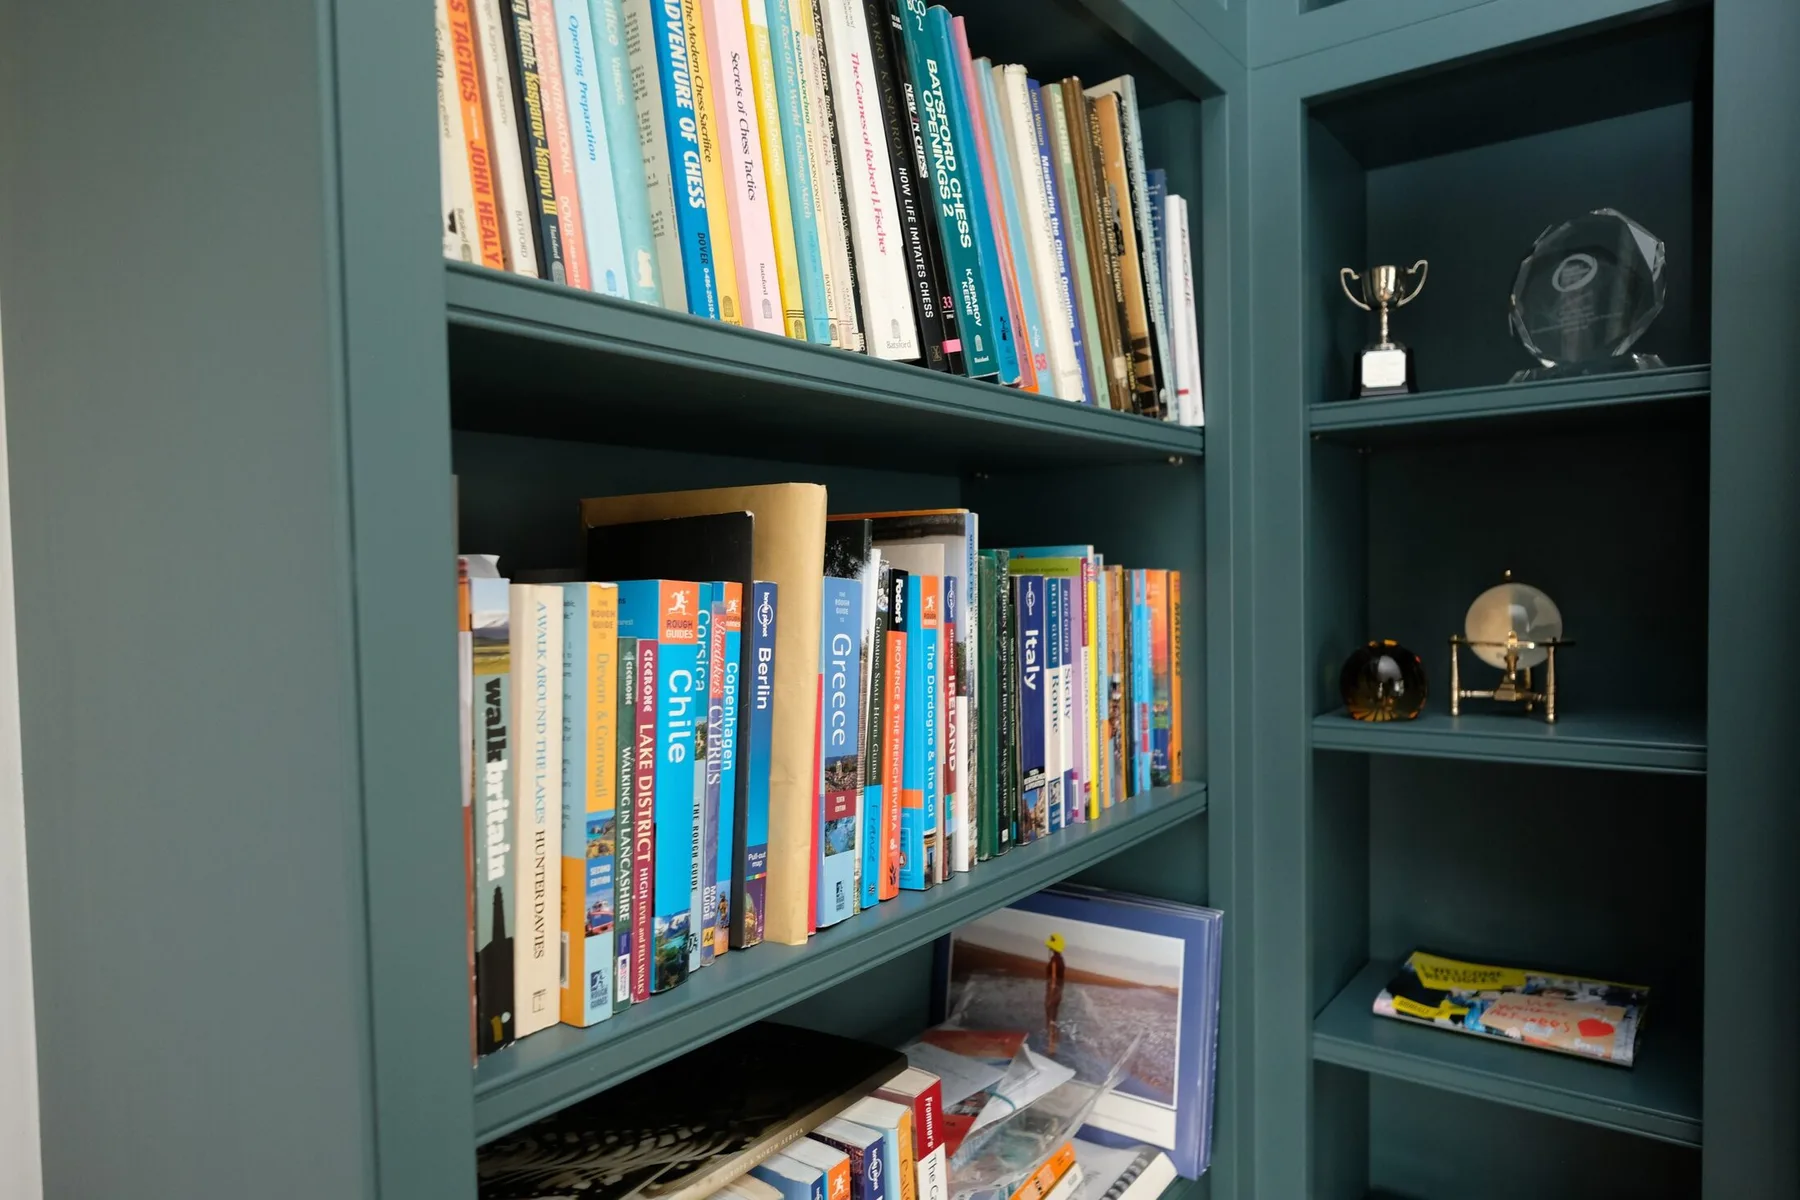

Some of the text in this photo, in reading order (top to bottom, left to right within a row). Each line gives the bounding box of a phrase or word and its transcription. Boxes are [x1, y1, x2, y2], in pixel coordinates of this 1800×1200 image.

[664, 0, 694, 110] DVENTURE
[687, 23, 701, 72] Modern
[812, 12, 826, 53] Master
[567, 15, 597, 162] Opening Preparation
[694, 74, 707, 112] Chess
[818, 54, 830, 91] Game
[453, 21, 501, 265] TACTICS JOHN HEALY
[550, 76, 570, 175] INTERNATIONAL
[679, 117, 696, 143] OF
[699, 113, 712, 163] Sacrifice
[904, 82, 918, 114] NEW
[914, 135, 929, 179] CHESS
[1033, 111, 1045, 146] Watson
[731, 51, 769, 296] Secrets of Chess Tactics Batsford
[789, 88, 802, 128] World
[801, 184, 812, 218] Match
[850, 52, 888, 255] The Games of Robert Fischer
[866, 3, 934, 319] GARRY KASPAROV HOW LIFE IMITATES CHESS
[921, 90, 955, 217] OPENINGS 2
[926, 58, 972, 249] BATSFORD CHESS
[682, 151, 706, 209] CHESS
[1041, 154, 1056, 214] Mastering
[542, 199, 557, 215] III
[560, 195, 575, 237] DOVER
[1051, 215, 1060, 236] the
[514, 210, 528, 259] BATSFORD
[697, 231, 709, 264] DOVER
[1054, 238, 1067, 273] Chess
[824, 273, 833, 312] BATSFORD
[961, 281, 973, 316] KEENE
[965, 267, 982, 328] KASPAROV
[1034, 352, 1048, 371] 58
[591, 609, 615, 618] ROUGH
[592, 620, 614, 629] GUIDE
[666, 619, 693, 629] ROUGH
[835, 598, 850, 606] ROUGH
[836, 607, 849, 615] GUIDE
[895, 578, 904, 624] Fodor's
[666, 629, 693, 640] GUIDES
[757, 591, 772, 710] lonely planet Berlin
[1024, 629, 1040, 691] Italy
[625, 660, 633, 705] CICERONE
[706, 616, 726, 785] Baedeker's CYPRUS
[832, 633, 852, 746] Greece
[873, 672, 881, 704] SMALL
[1051, 673, 1060, 734] Rome
[1063, 666, 1072, 720] Sicily
[594, 653, 609, 798] Devon & Cornwall
[668, 669, 694, 764] Chile
[723, 662, 739, 770] Copenhagen
[872, 706, 881, 739] HOTEL
[891, 638, 902, 832] PROVENCE & THE FRENCH RIVIERA
[925, 643, 937, 818] The Dordogne & the Lot
[947, 674, 957, 772] IRELAND
[622, 746, 632, 805] WALKING
[691, 609, 711, 892] Corsica THE ROUGH GUIDE
[872, 742, 880, 781] GUIDES
[533, 612, 548, 959] WALK AROUND THE LAKES HUNTER DAVIES
[620, 808, 630, 823] IN
[636, 648, 654, 995] CICERONE LAKE DISTRICT HIGH LEVEL and FELL WALKS
[619, 827, 631, 921] LANCASHIRE
[748, 852, 767, 862] Pull-out
[752, 860, 763, 868] map
[702, 886, 711, 921] GUIDE
[709, 885, 718, 909] MAP
[924, 1096, 938, 1184] Frommer's The
